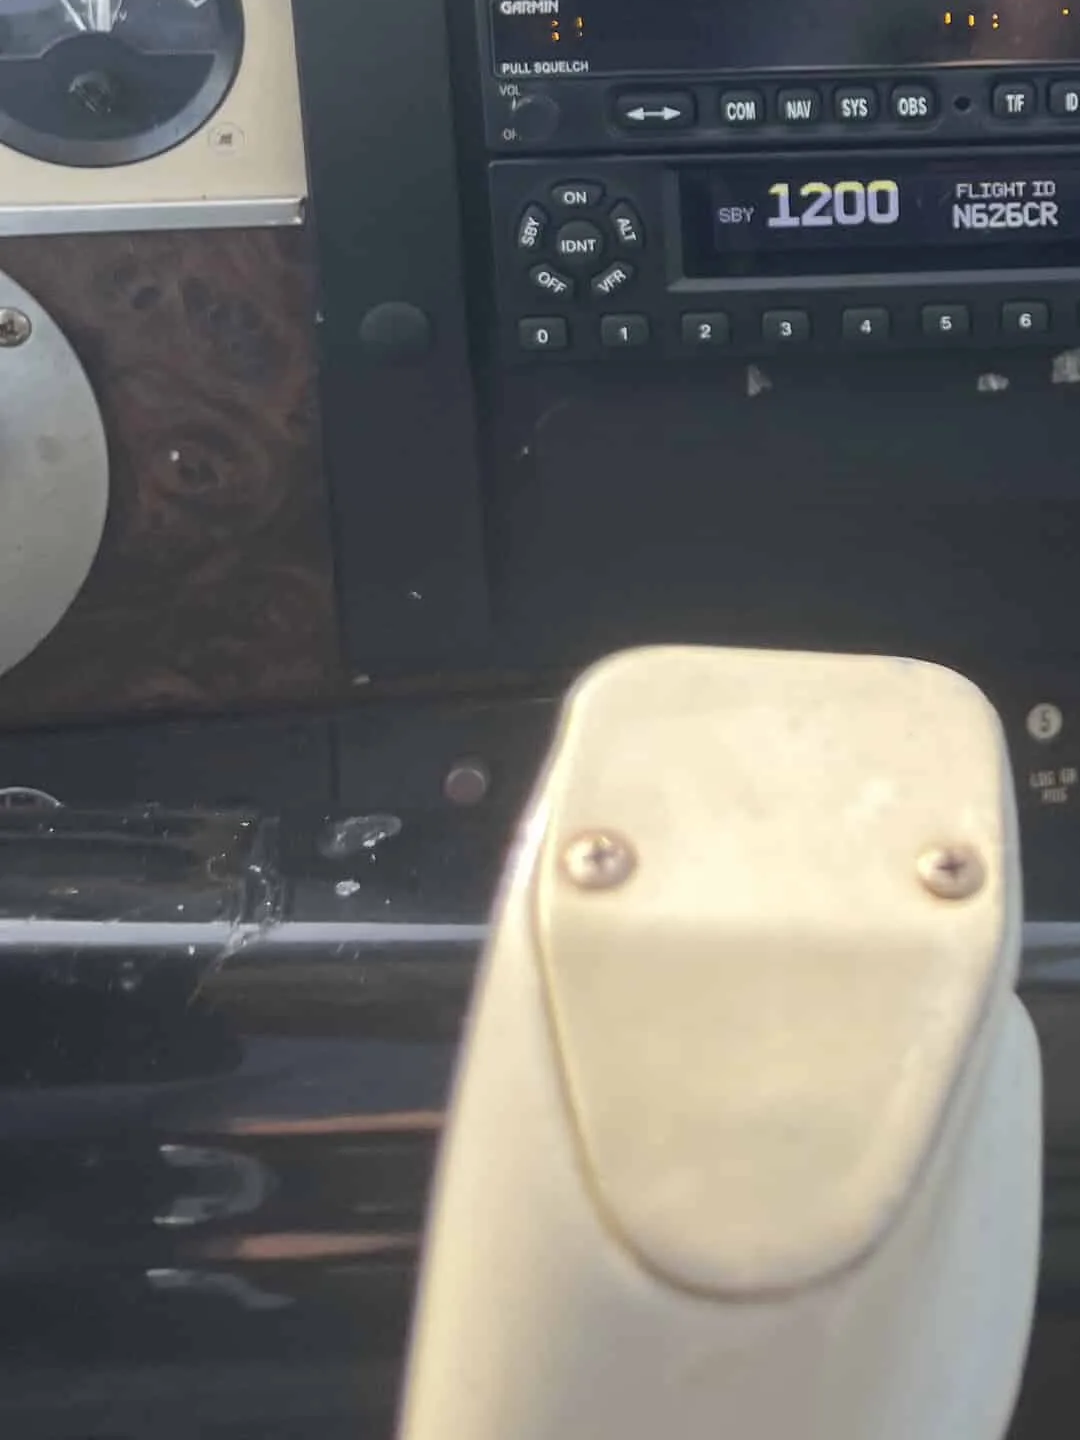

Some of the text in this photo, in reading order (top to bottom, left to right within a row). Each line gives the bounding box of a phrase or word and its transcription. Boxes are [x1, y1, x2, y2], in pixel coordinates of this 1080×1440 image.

[500, 0, 560, 15] GARMIN
[501, 60, 590, 75] PULL SQUELCH
[727, 101, 756, 121] COM
[786, 100, 812, 119] NAV
[841, 98, 869, 118] SYS
[898, 97, 928, 116] OBS
[1065, 93, 1079, 112] ID
[956, 179, 1057, 198] FLIGHT ID
[563, 191, 588, 205] ON
[767, 179, 900, 229] 1200
[718, 206, 755, 224] SBY
[952, 202, 1059, 229] N626CR
[521, 216, 541, 248] SBY
[615, 216, 637, 243] ALT
[560, 237, 597, 253] IDNT
[536, 270, 567, 295] OFF
[597, 268, 628, 294] VFR
[780, 321, 792, 337] 3
[860, 319, 873, 334] 4
[939, 315, 952, 330] 5
[1018, 312, 1032, 328] 6
[536, 328, 549, 344] 0
[619, 326, 629, 341] 1
[699, 323, 712, 339] 2
